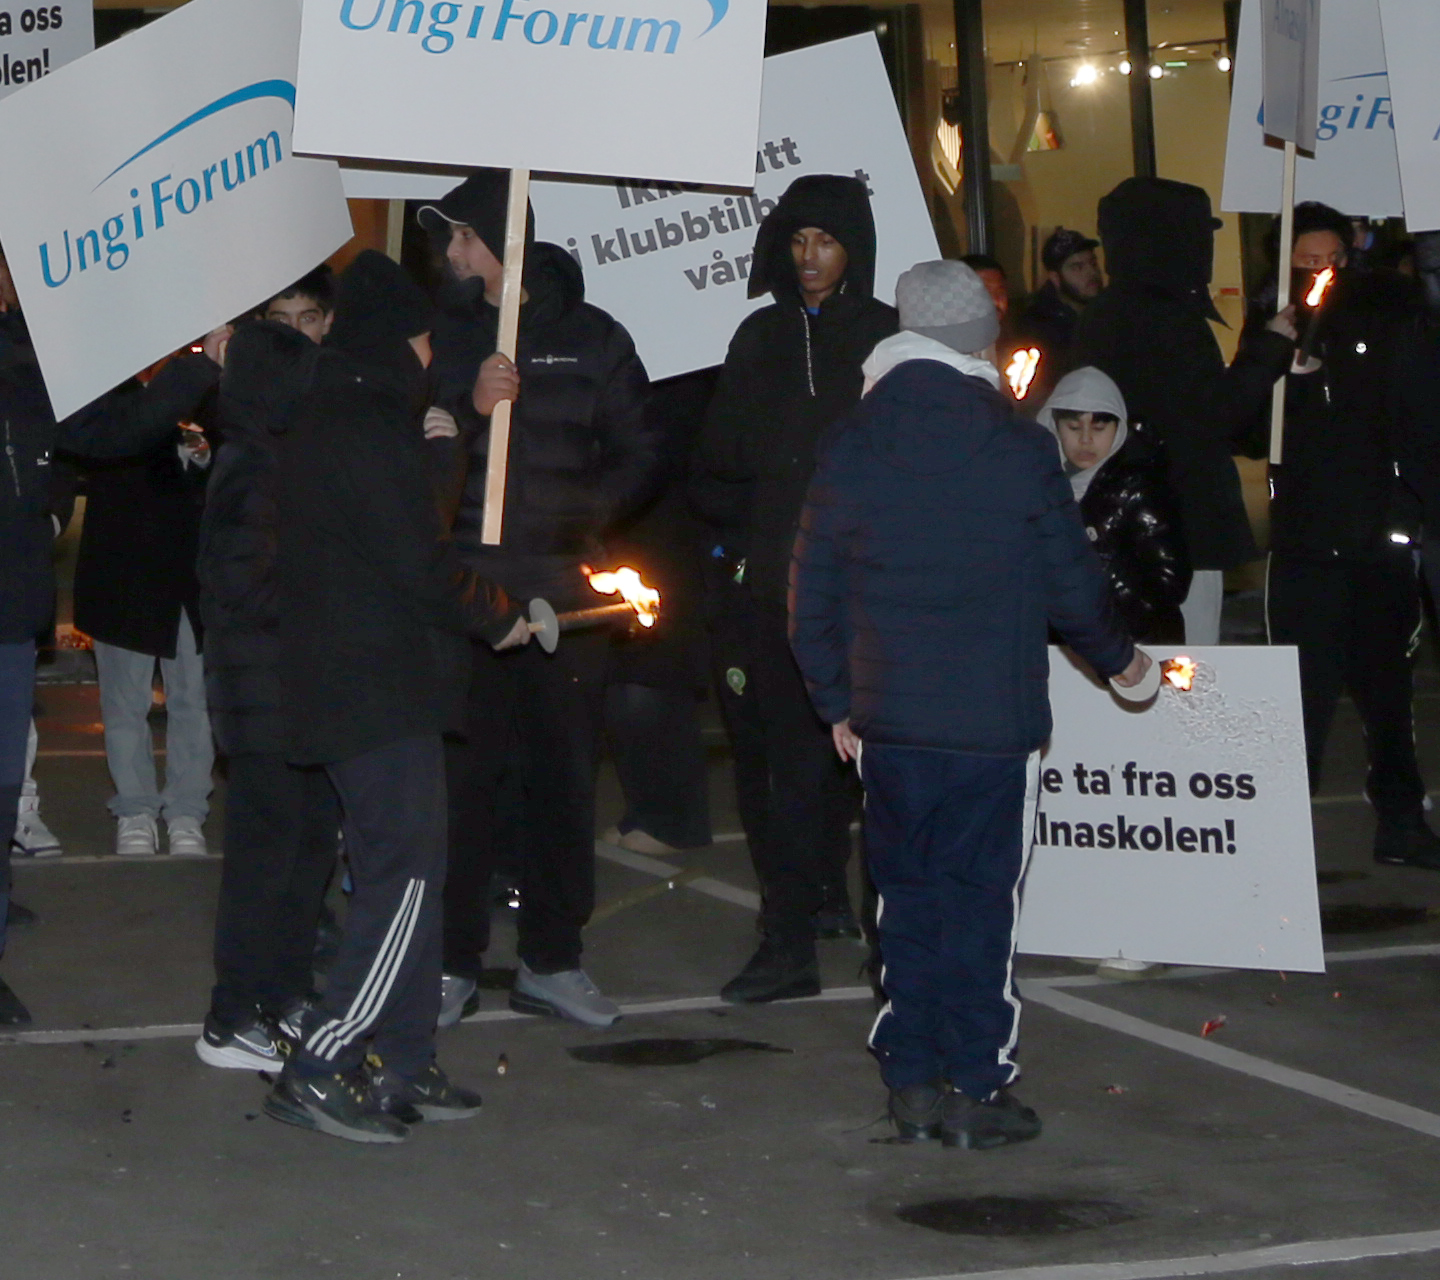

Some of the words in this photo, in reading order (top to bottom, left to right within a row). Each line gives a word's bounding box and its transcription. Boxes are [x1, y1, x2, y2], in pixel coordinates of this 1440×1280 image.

[20, 5, 63, 33] oss
[683, 247, 756, 291] vår
[1073, 762, 1111, 795] ta
[1122, 761, 1177, 798] fra
[1189, 772, 1256, 800] oss
[1033, 812, 1236, 855] lnaskolen!
